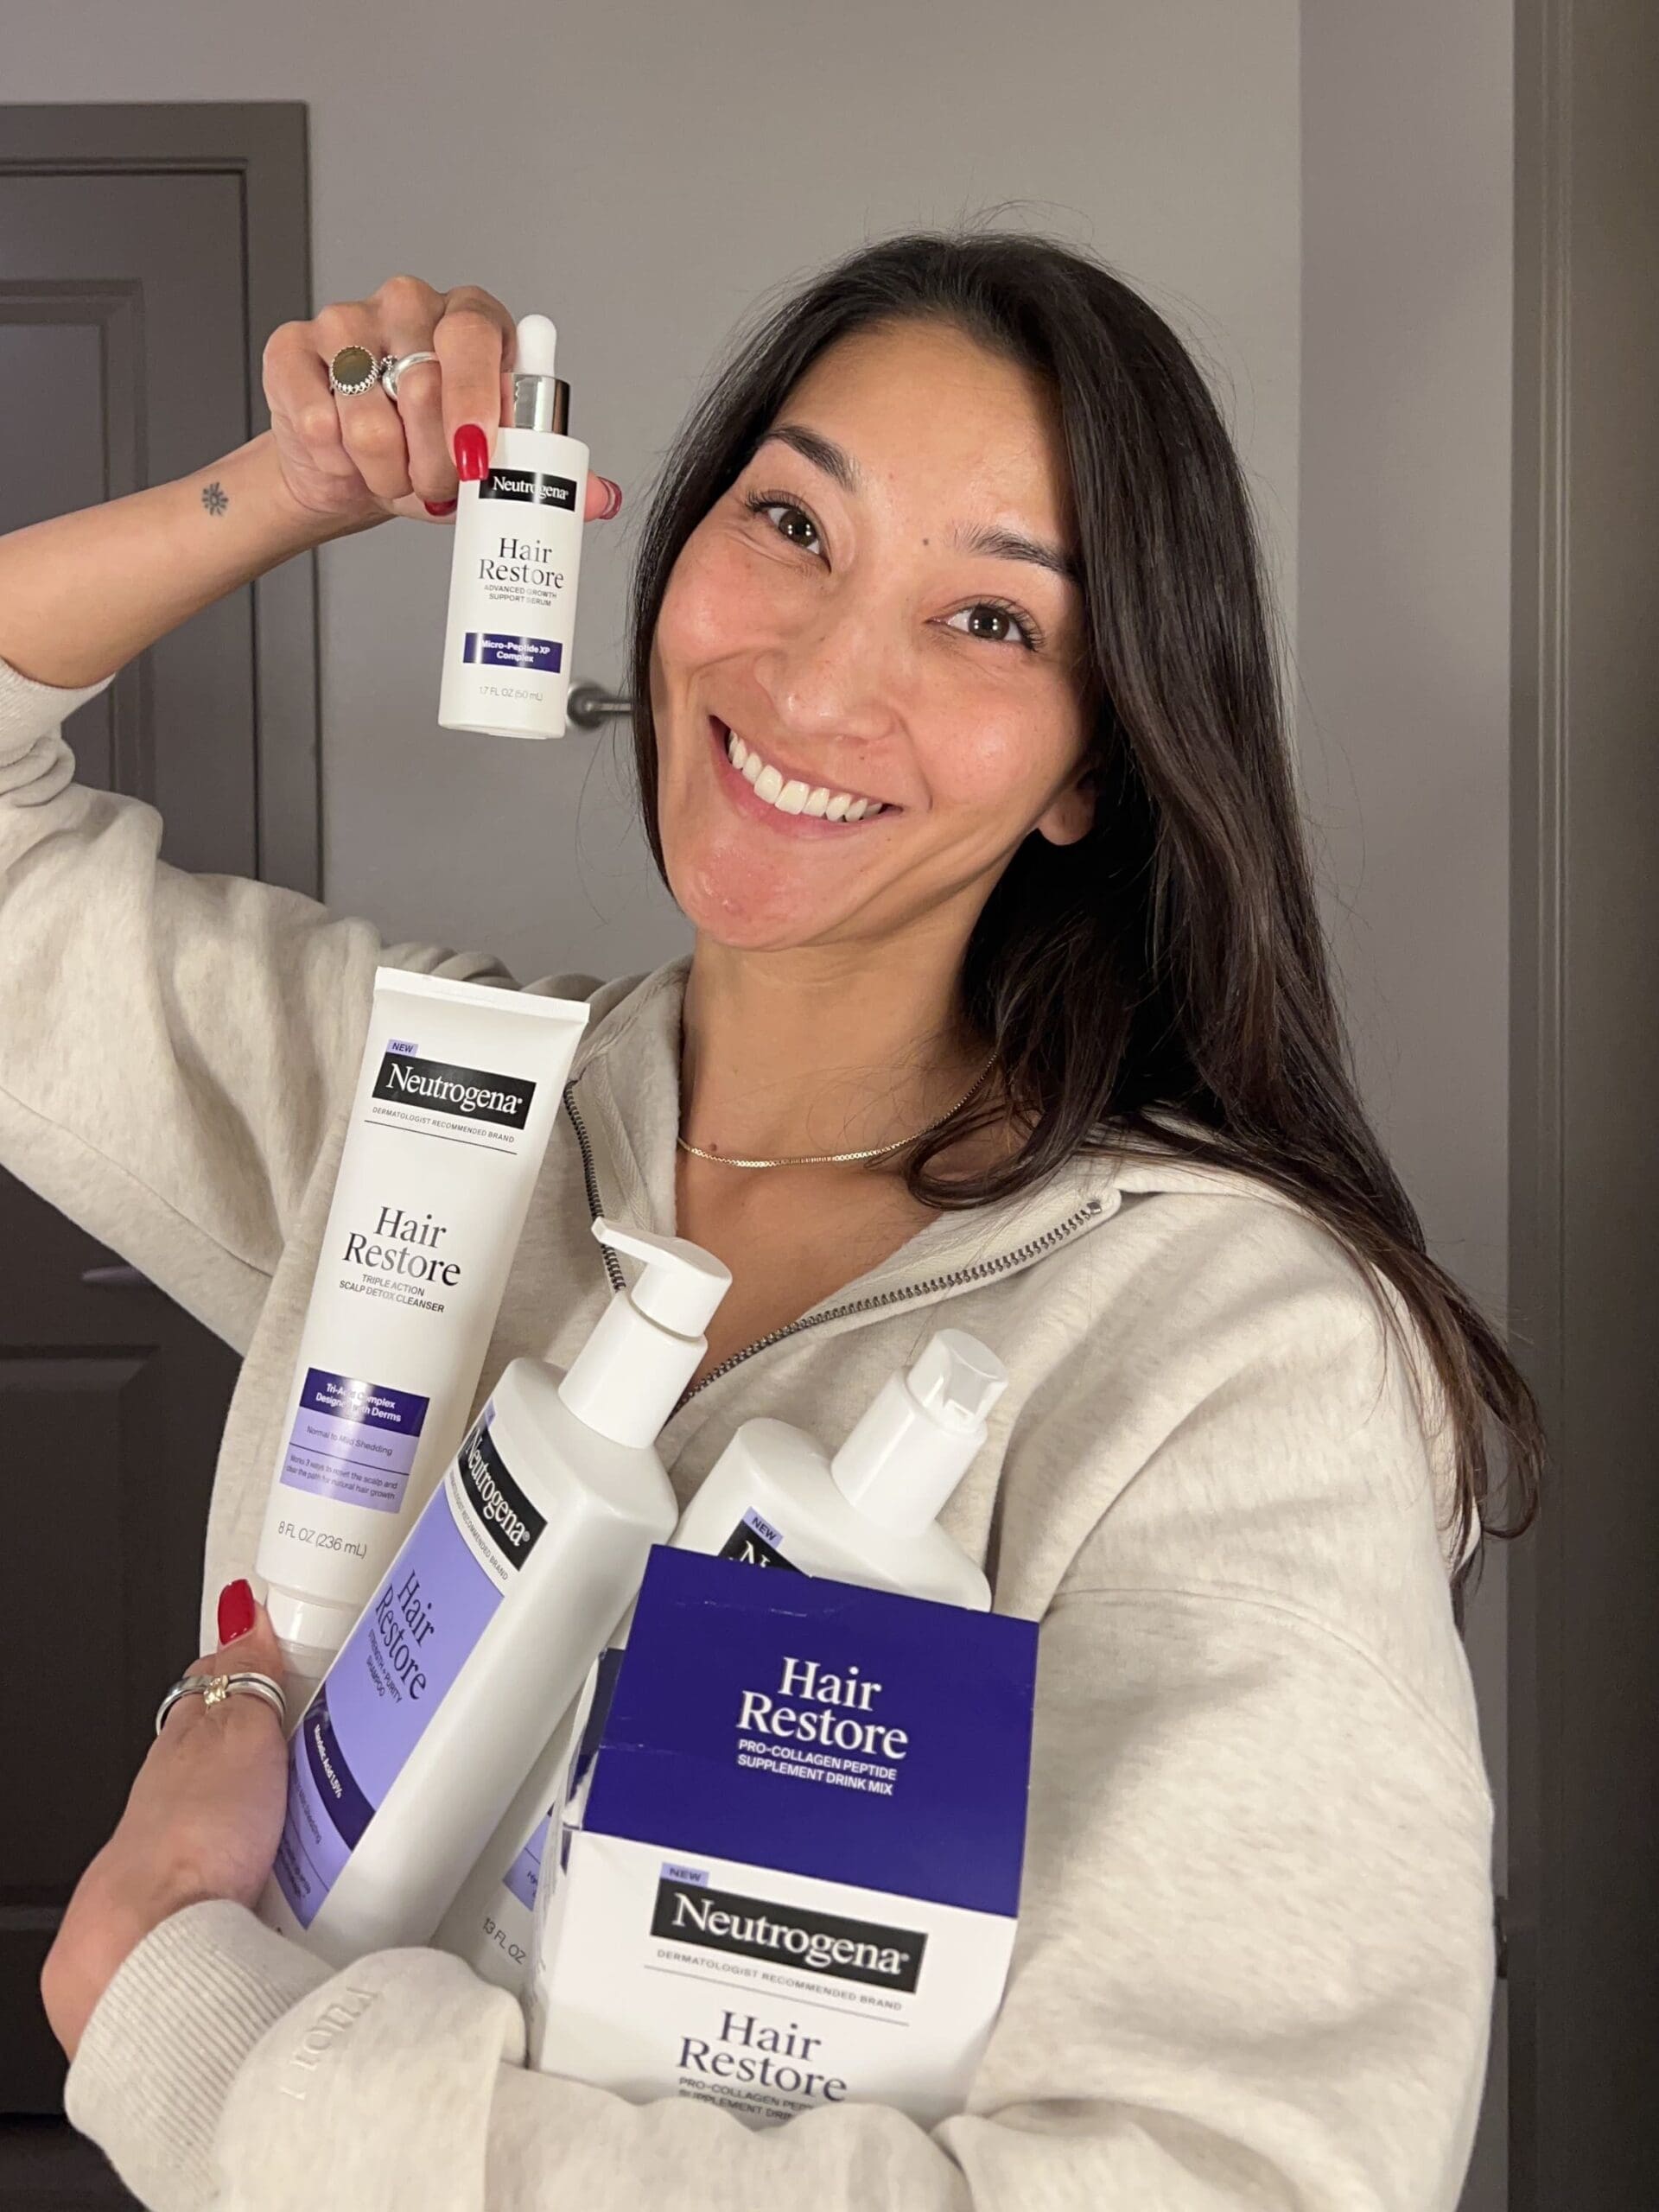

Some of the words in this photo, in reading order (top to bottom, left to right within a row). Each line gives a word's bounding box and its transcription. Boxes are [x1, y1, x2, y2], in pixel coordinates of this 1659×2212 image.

[499, 537, 552, 563] Hair
[479, 559, 564, 588] Restore
[484, 585, 525, 594] ADVANCED
[526, 588, 557, 599] GROWTH
[489, 593, 524, 603] SUPPORT
[526, 596, 551, 607] SERUM
[496, 651, 534, 663] Complex
[539, 645, 550, 654] XP
[391, 1042, 414, 1053] NEW
[372, 1106, 431, 1125] DERMATOLOGIST
[432, 1119, 486, 1137] RECOMMENDED
[487, 1130, 515, 1143] BRAND
[373, 1206, 447, 1249] Hair
[342, 1232, 461, 1287] Restore
[339, 1280, 365, 1293] SCALP
[365, 1287, 395, 1300] DETOX
[396, 1294, 445, 1313] CLEANSER
[362, 1274, 391, 1287] TRIPLE
[391, 1282, 425, 1296] ACTION
[372, 1407, 402, 1422] Derms
[356, 1440, 392, 1456] Shedding
[351, 1471, 362, 1481] the
[364, 1476, 383, 1486] scalp
[384, 1480, 397, 1490] and
[370, 1489, 395, 1500] growth
[278, 1521, 285, 1535] 8
[285, 1523, 296, 1538] FL
[298, 1528, 315, 1543] OZ
[315, 1533, 342, 1551] (236
[344, 1541, 367, 1559] mL)
[751, 1516, 777, 1541] NEW
[489, 1555, 509, 1581] BRAND
[397, 1569, 435, 1648] Hair
[375, 1582, 427, 1700] Restore
[778, 1656, 882, 1711] Hair
[736, 1690, 908, 1759] Restore
[739, 1738, 842, 1770] PRO-COLLAGEN
[842, 1759, 897, 1781] PEPTIDE
[738, 1755, 824, 1781] SUPPLEMENT
[826, 1772, 867, 1790] DRINK
[868, 1783, 893, 1796] MIX
[670, 1868, 702, 1882] NEW
[483, 1918, 496, 1935] 13
[494, 1929, 506, 1949] FL
[508, 1943, 527, 1965] OZ
[657, 1948, 759, 1979] DERMATOLOGIST
[761, 1973, 857, 2002] RECOMMENDED
[860, 1994, 902, 2011] BRAND
[716, 2009, 822, 2062] Hair
[676, 2036, 848, 2102] Restore
[679, 2077, 780, 2106] PRO-COLLAGEN
